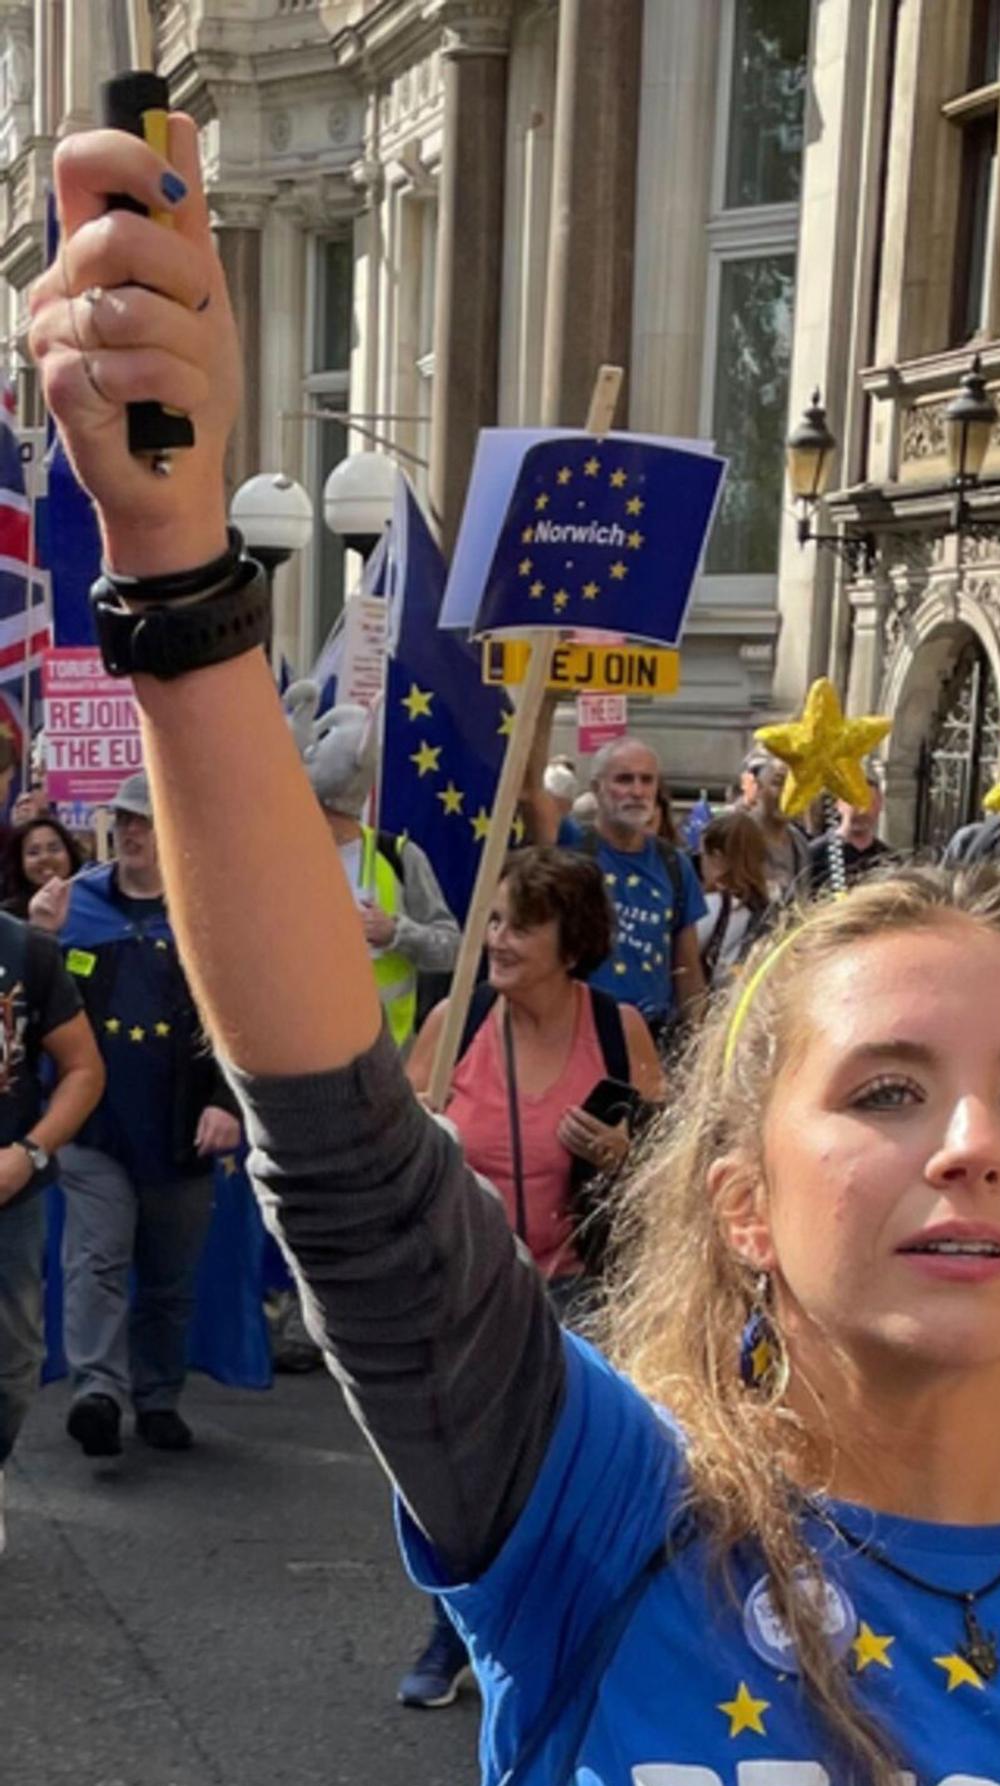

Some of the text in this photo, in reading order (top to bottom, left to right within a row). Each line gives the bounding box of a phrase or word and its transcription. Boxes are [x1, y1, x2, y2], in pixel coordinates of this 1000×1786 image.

[534, 519, 625, 547] Norwich
[533, 649, 657, 687] EJOIN
[50, 700, 139, 728] REJOIN
[51, 738, 142, 767] THE EU
